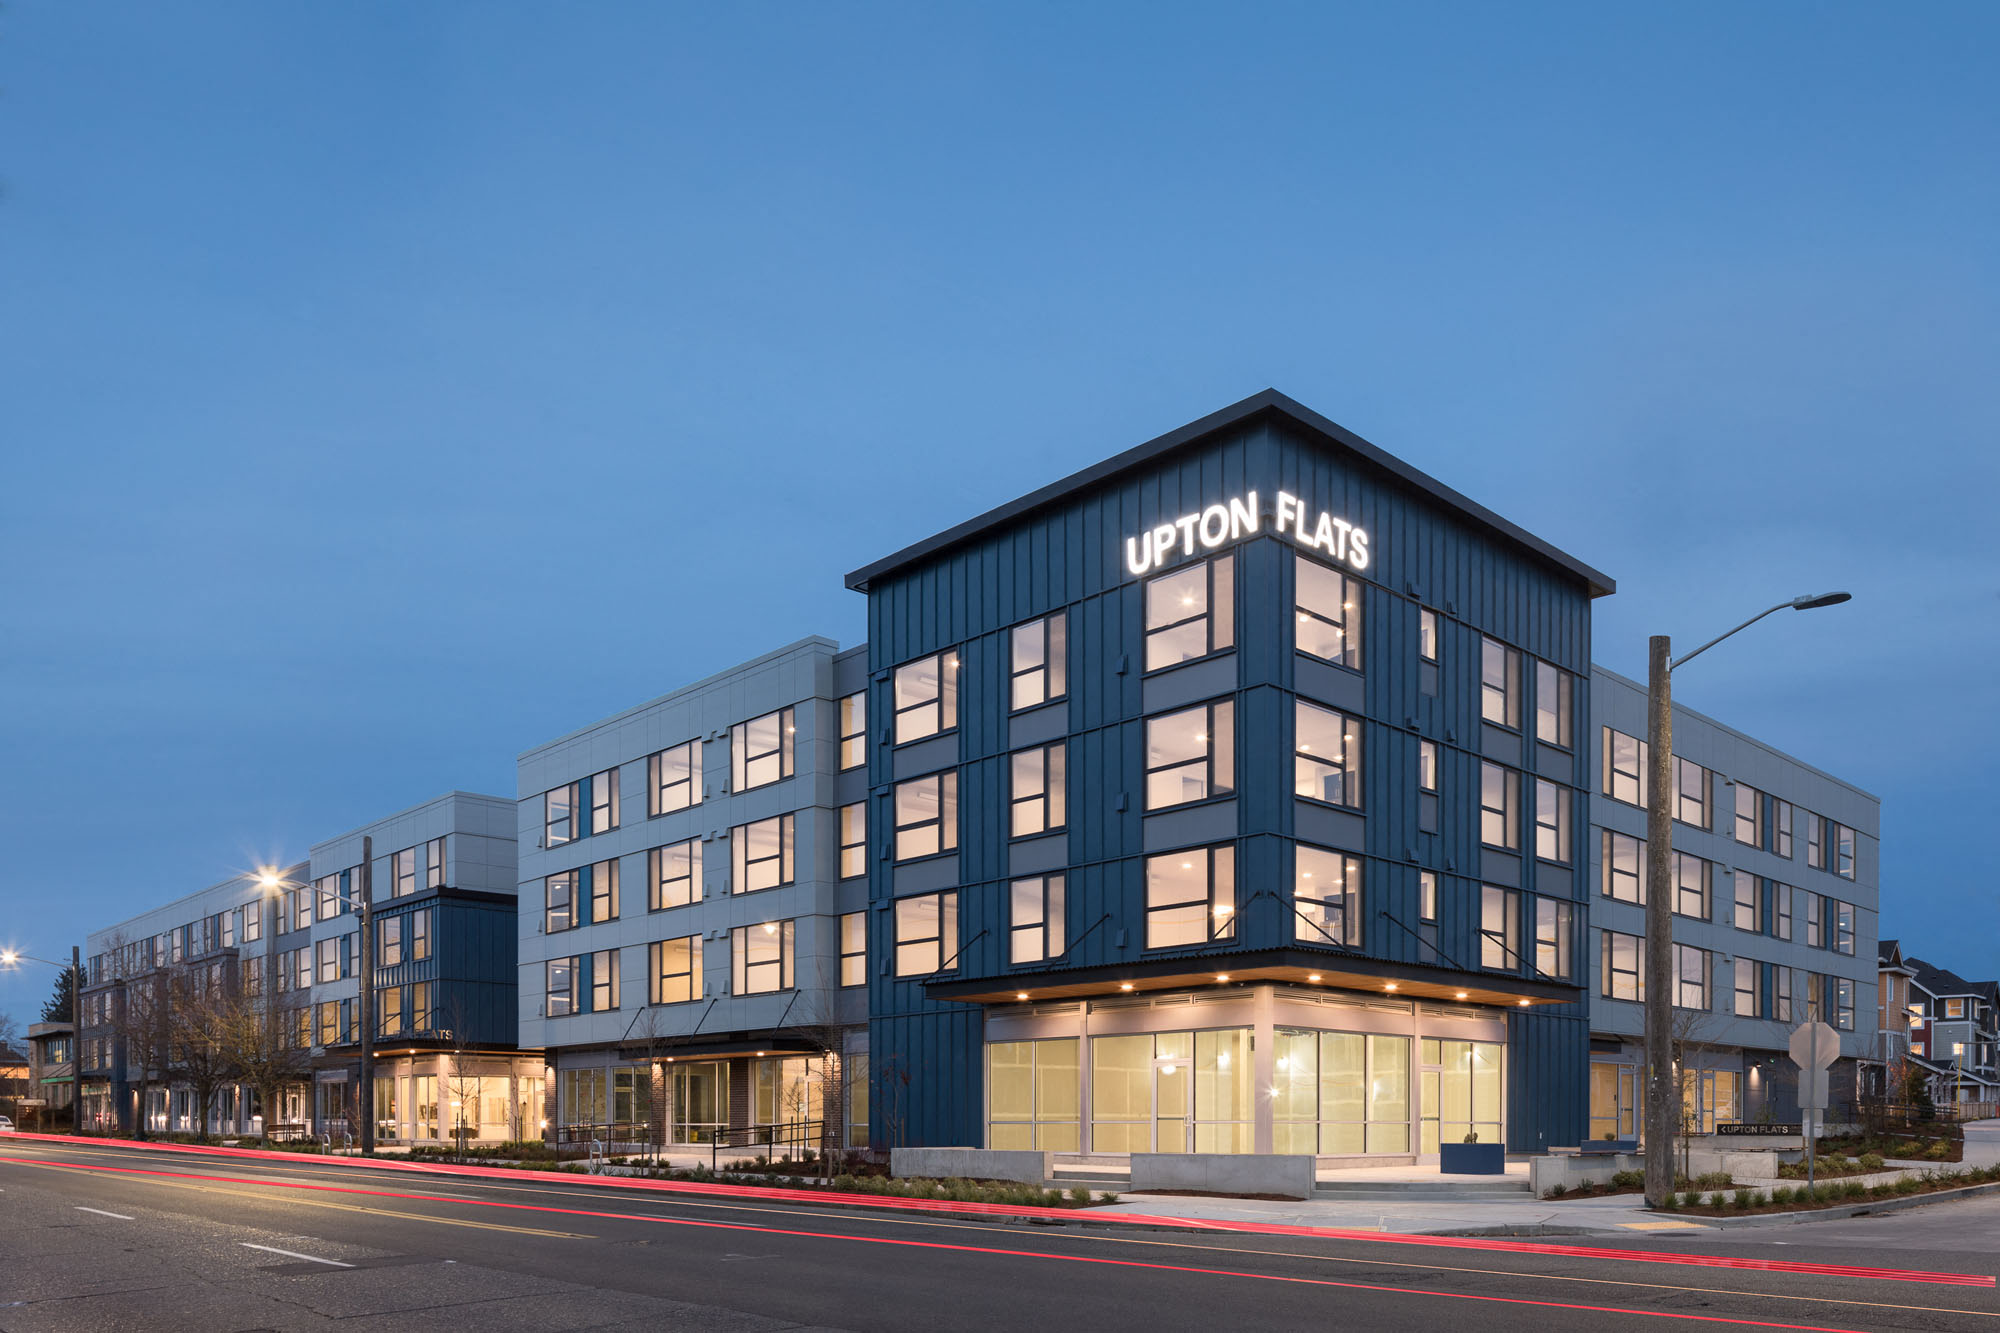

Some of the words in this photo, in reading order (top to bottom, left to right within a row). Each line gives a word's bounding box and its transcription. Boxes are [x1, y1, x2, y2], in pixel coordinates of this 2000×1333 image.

[1127, 491, 1258, 574] UPTON
[1277, 491, 1368, 570] FLATS
[1727, 1125, 1757, 1134] UPTON
[1760, 1125, 1788, 1134] FLATS
